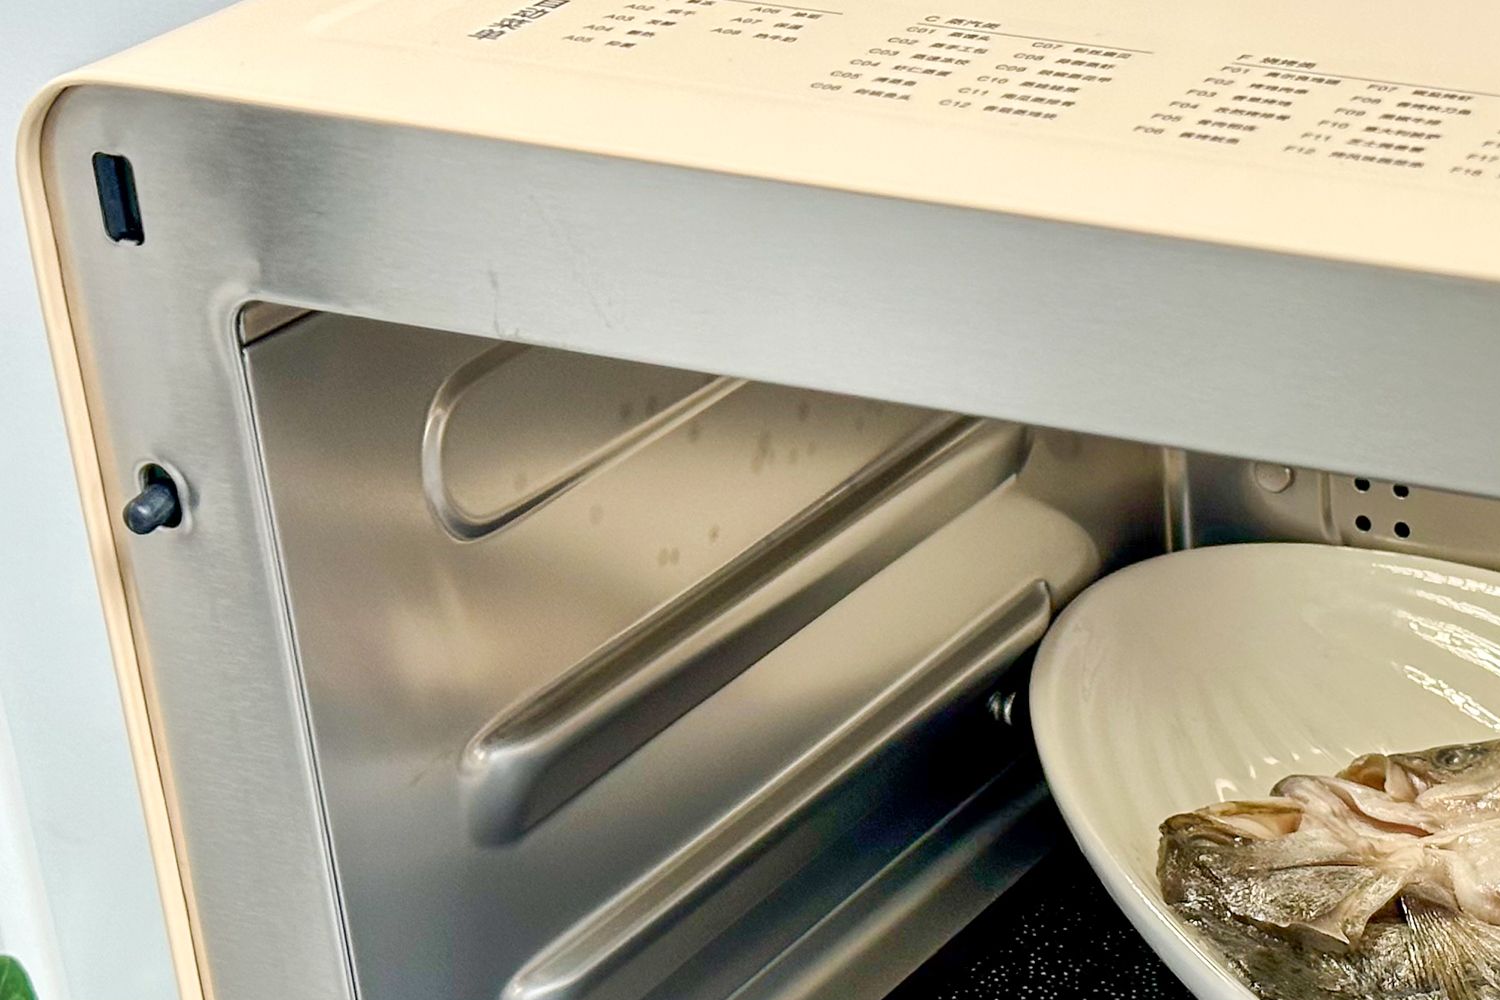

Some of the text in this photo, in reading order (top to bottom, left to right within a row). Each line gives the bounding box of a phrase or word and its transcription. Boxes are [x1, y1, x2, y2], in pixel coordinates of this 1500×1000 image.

[730, 16, 764, 25] A07
[583, 24, 615, 32] A04
[906, 26, 937, 35] C01
[887, 36, 920, 46] C02
[1031, 41, 1064, 50] C07
[868, 47, 901, 57] C03
[849, 58, 881, 68] C04
[1220, 65, 1251, 75] F01
[976, 75, 1009, 85] C10
[1203, 77, 1235, 86] F02
[957, 87, 989, 96] C11
[1186, 88, 1218, 98] F03
[1366, 83, 1399, 93] F07
[938, 99, 972, 109] C12
[1168, 100, 1200, 110] F04
[1317, 119, 1350, 129] F10
[1300, 132, 1332, 142] F11
